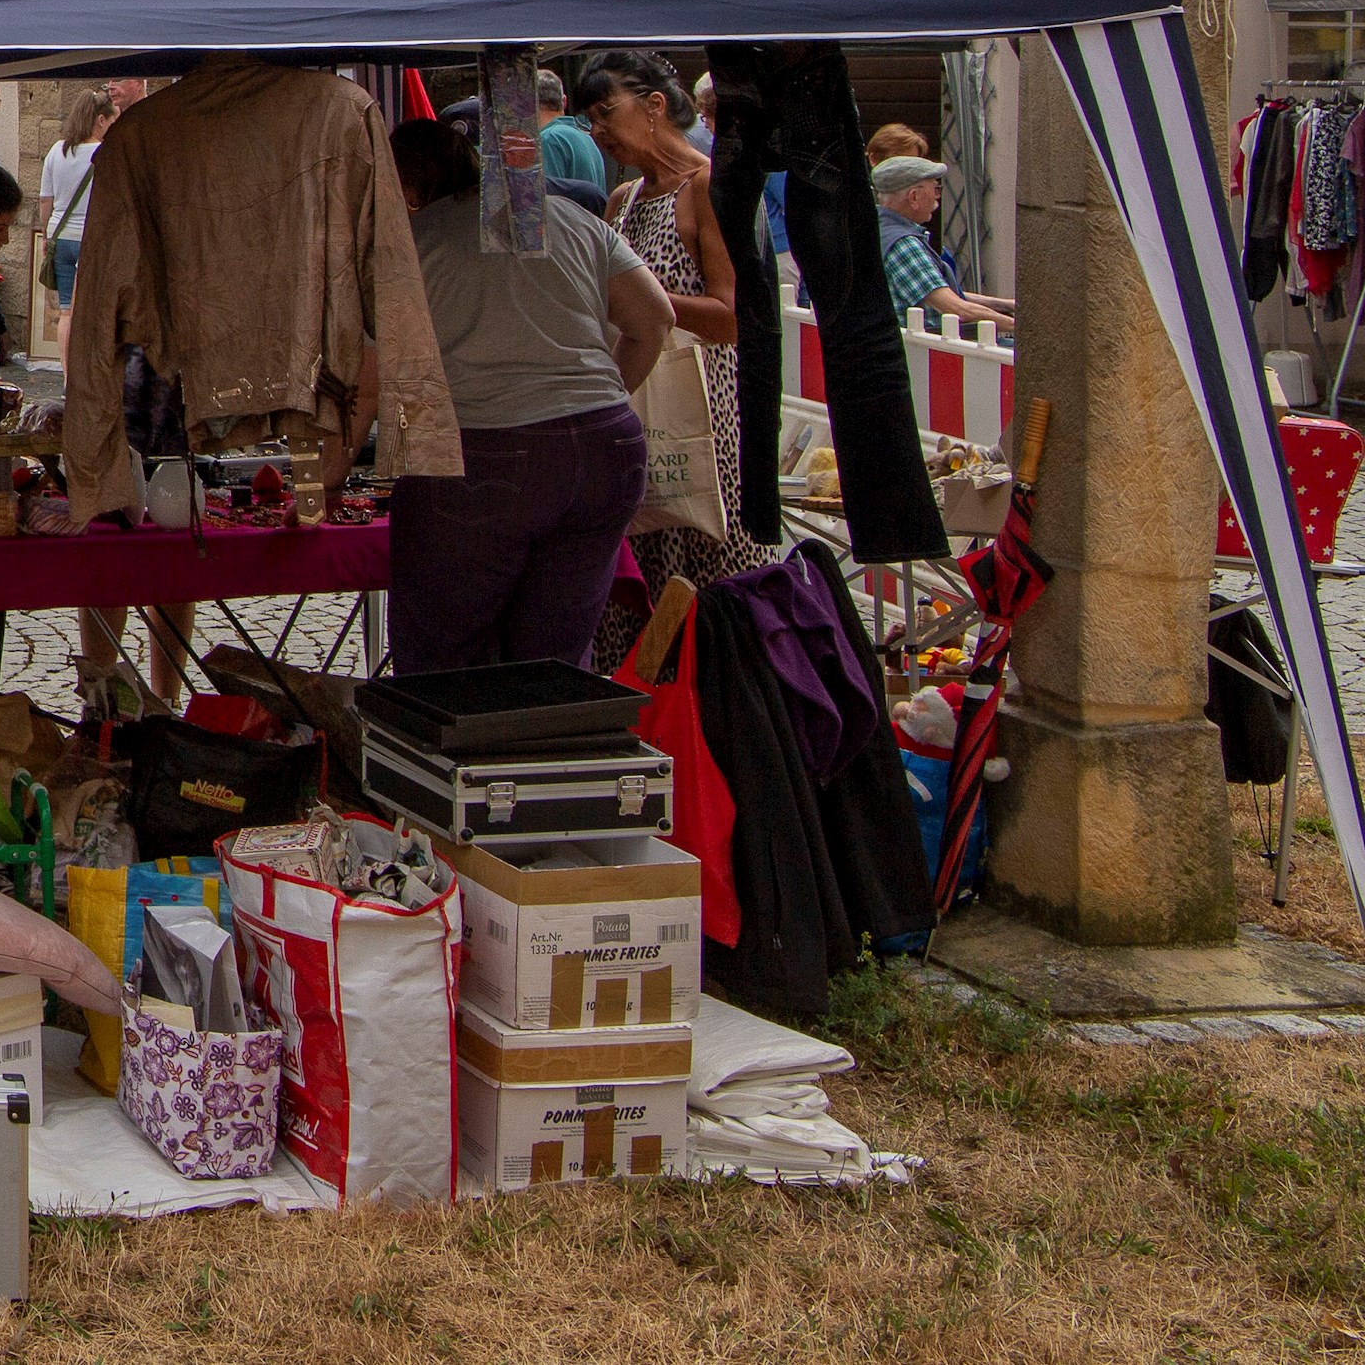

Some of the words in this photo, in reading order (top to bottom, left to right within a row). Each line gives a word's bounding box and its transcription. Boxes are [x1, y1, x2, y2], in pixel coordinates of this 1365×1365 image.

[643, 424, 665, 440] hre
[647, 453, 689, 468] KARD
[194, 779, 234, 800] Netto
[595, 920, 629, 934] Potato
[530, 932, 563, 943] Art.Nr.
[530, 945, 558, 955] 13328
[564, 946, 617, 963] MMES
[619, 944, 661, 961] FRITES
[543, 1109, 586, 1124] POMM
[613, 1105, 647, 1121] RITES
